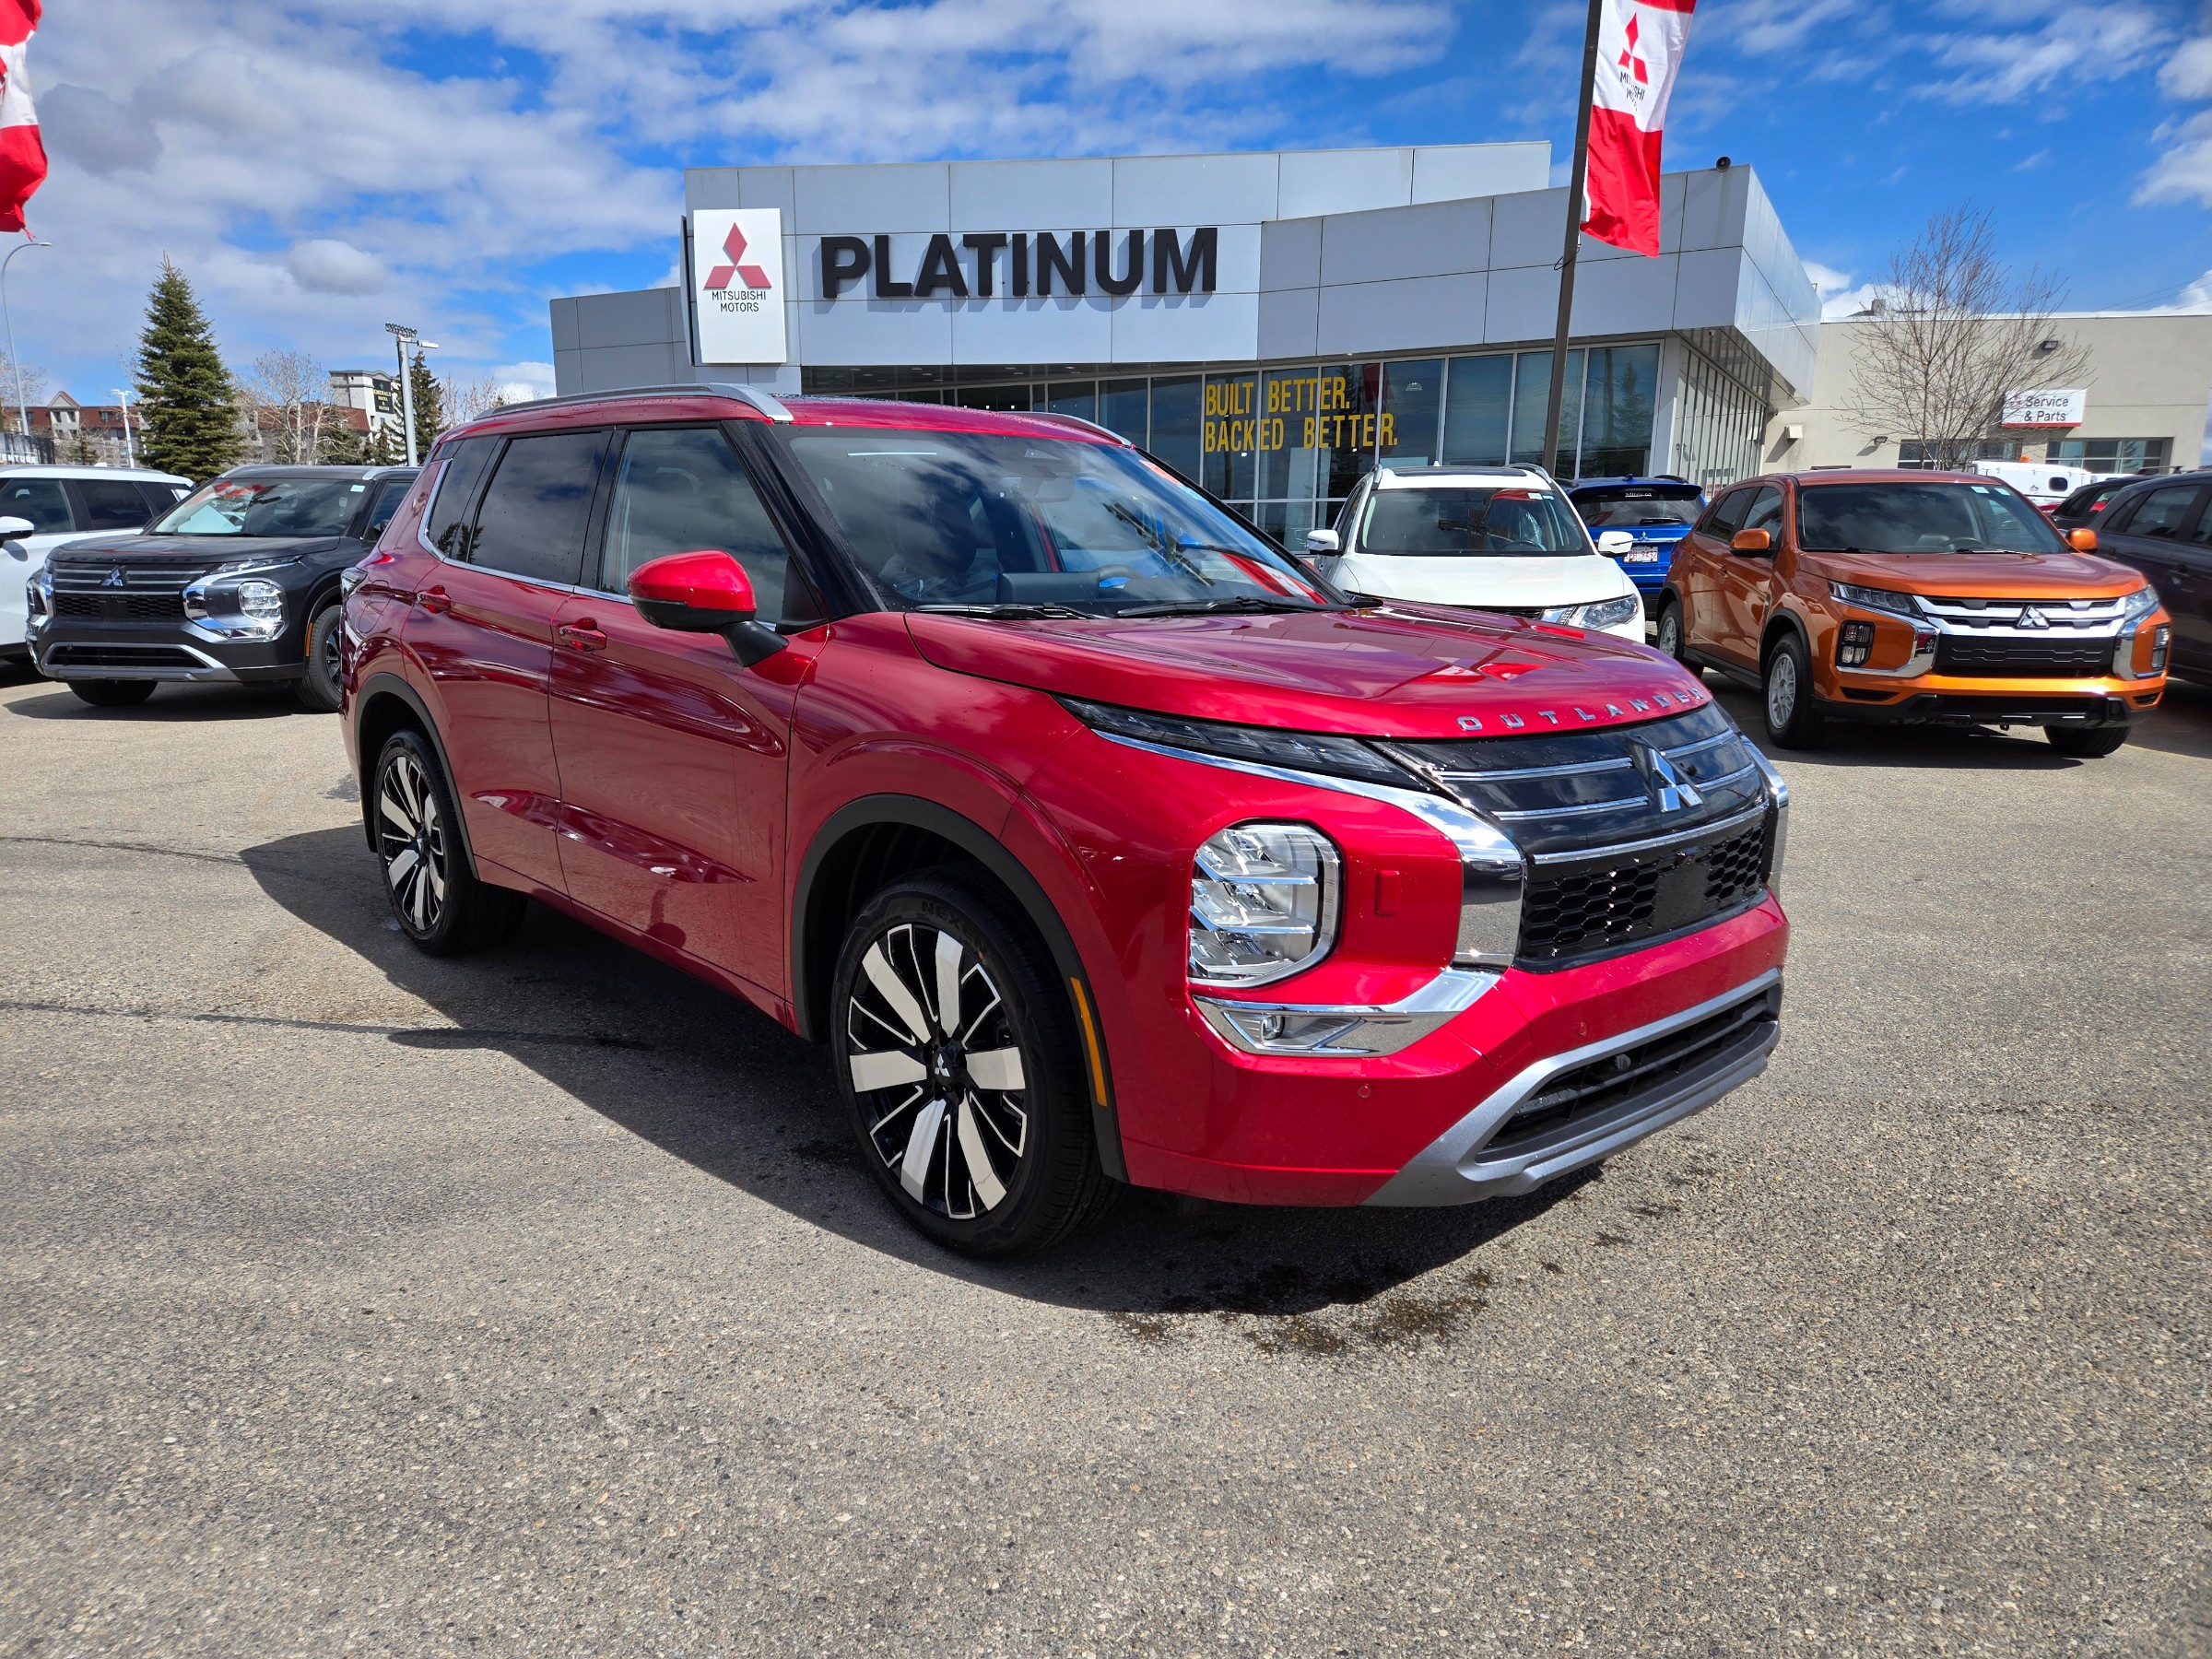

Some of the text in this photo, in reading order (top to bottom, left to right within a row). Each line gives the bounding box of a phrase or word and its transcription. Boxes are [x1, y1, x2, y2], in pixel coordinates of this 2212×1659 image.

[820, 227, 1218, 299] PLATINUM
[712, 290, 766, 300] MITSUBISHI
[720, 302, 759, 312] MOTORS
[1206, 376, 1350, 416] BUILT BETTER.
[2025, 395, 2069, 407] Service
[2024, 410, 2066, 422] & Parts
[1205, 413, 1398, 453] BACKED BETTER.
[1456, 687, 1705, 731] OUTLANDER
